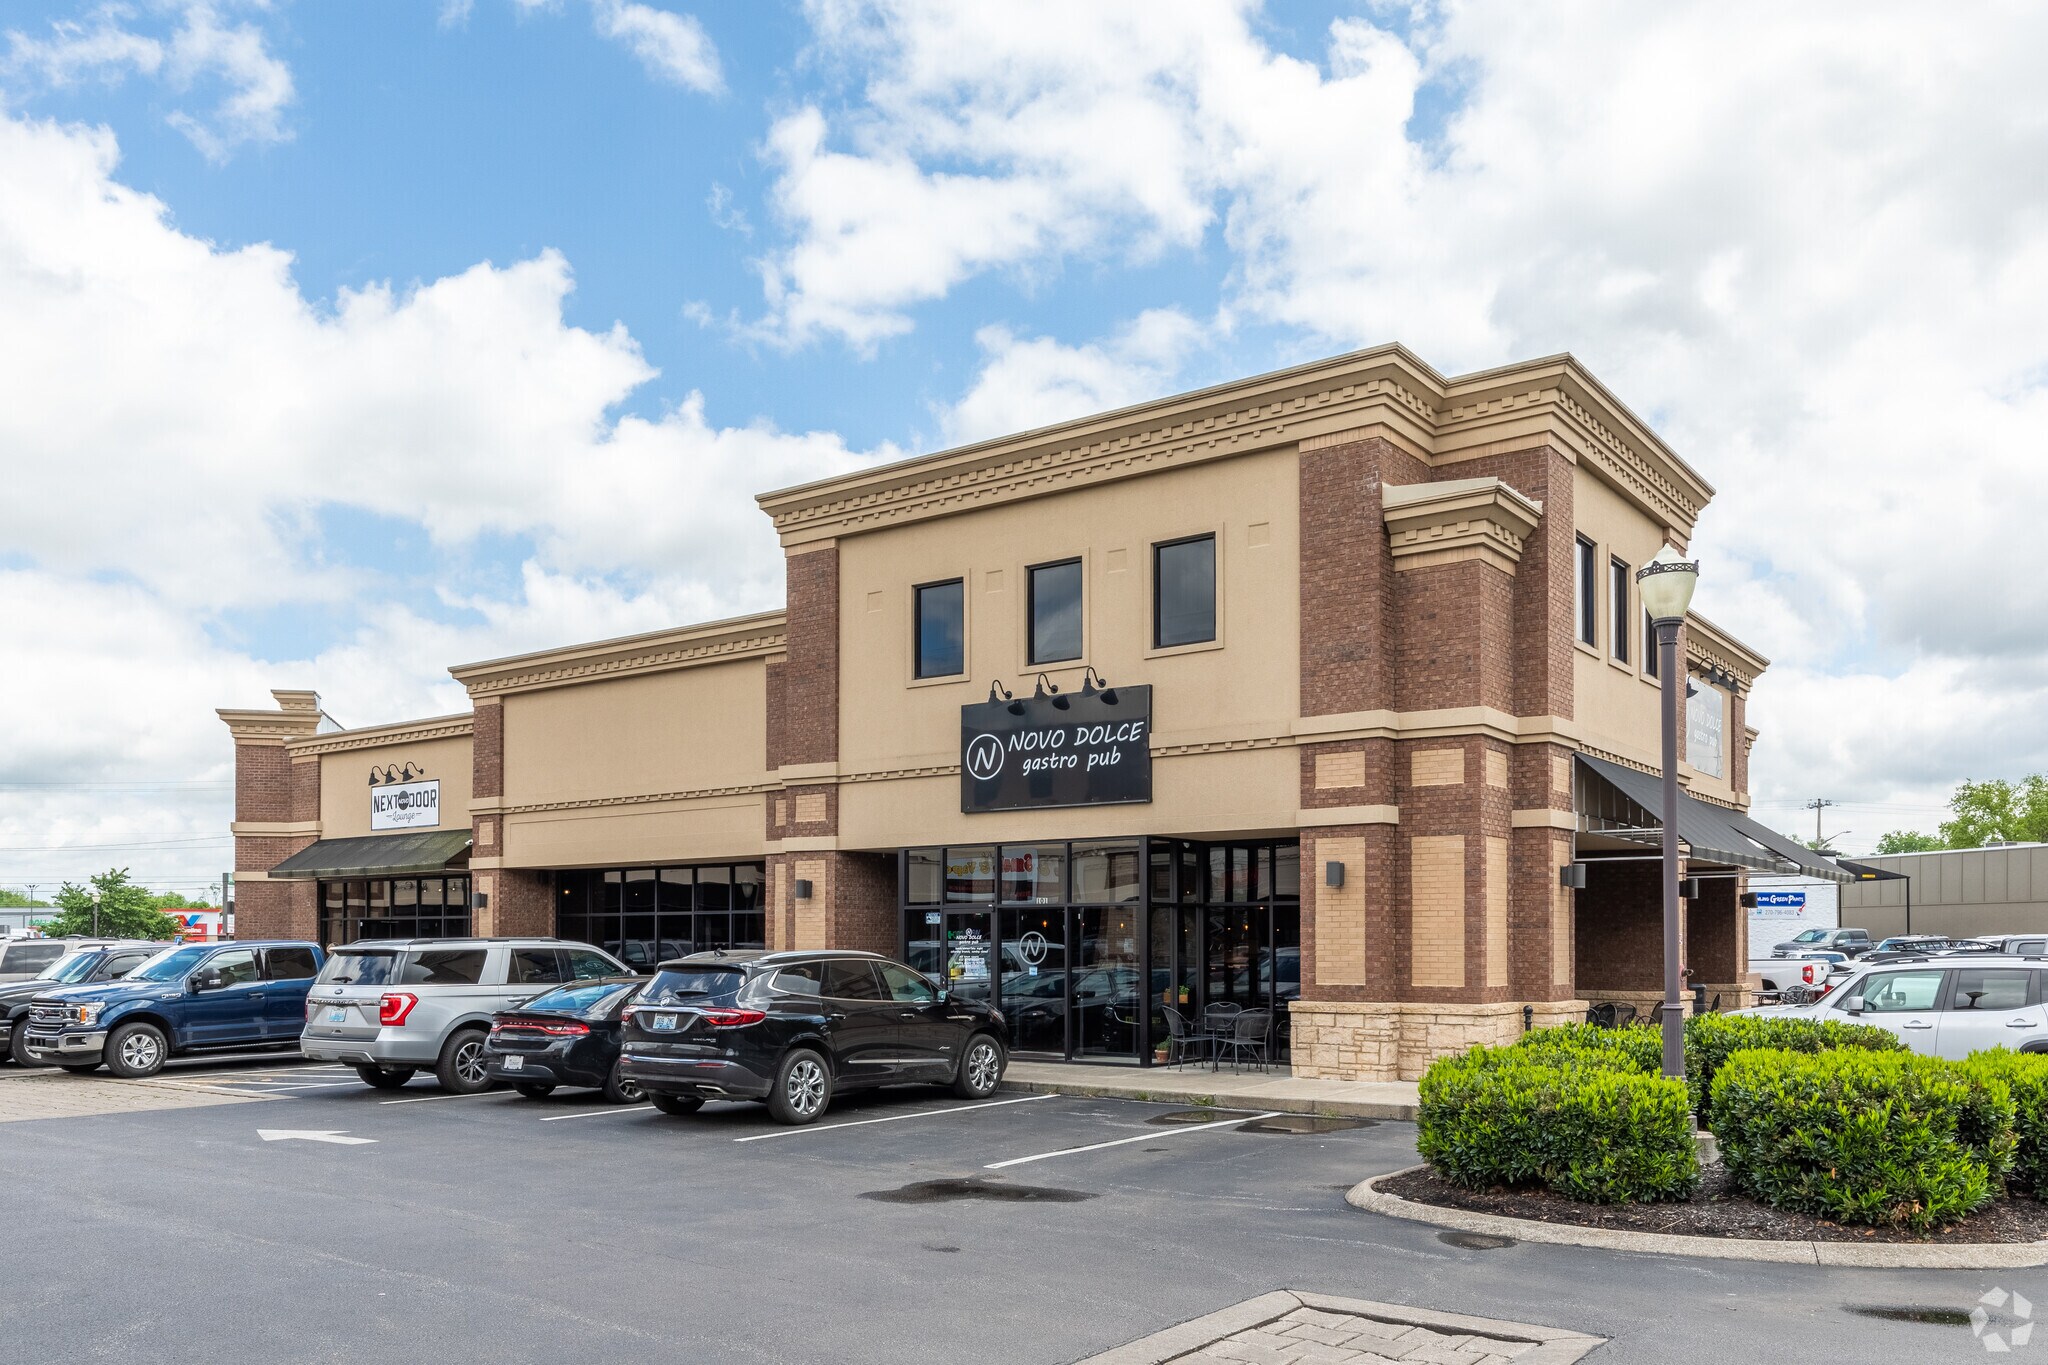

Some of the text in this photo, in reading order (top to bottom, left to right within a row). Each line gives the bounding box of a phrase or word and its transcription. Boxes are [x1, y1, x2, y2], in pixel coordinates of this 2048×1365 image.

[1008, 721, 1145, 752] NOVO DOLCE
[974, 742, 997, 771] N
[1022, 745, 1122, 776] gastro pub
[373, 789, 437, 813] NEXT DOOR
[392, 811, 415, 824] Lounge
